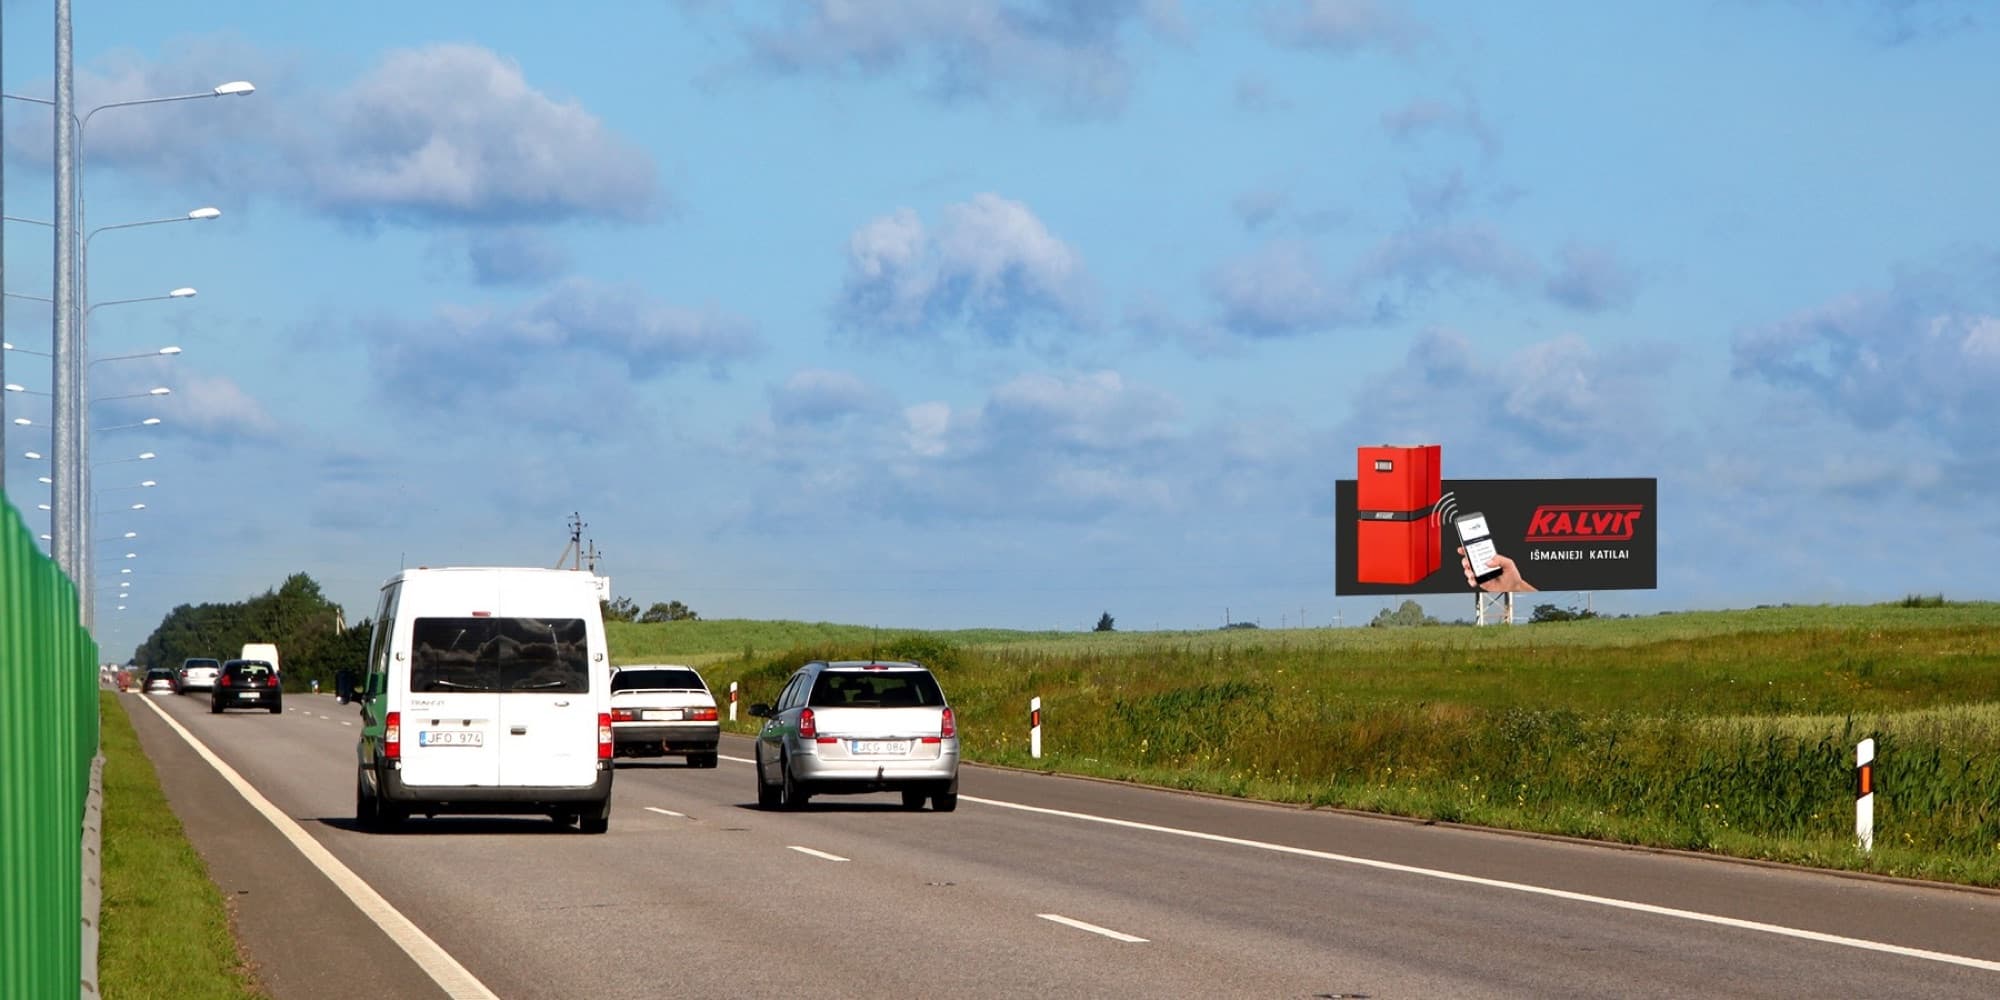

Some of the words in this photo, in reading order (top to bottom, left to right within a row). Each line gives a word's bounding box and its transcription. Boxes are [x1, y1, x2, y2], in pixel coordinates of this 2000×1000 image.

[1526, 505, 1642, 541] KALVIS
[1530, 549, 1583, 560] IŠMANIEJI
[1589, 549, 1629, 560] KATILAI
[427, 733, 452, 744] JFO
